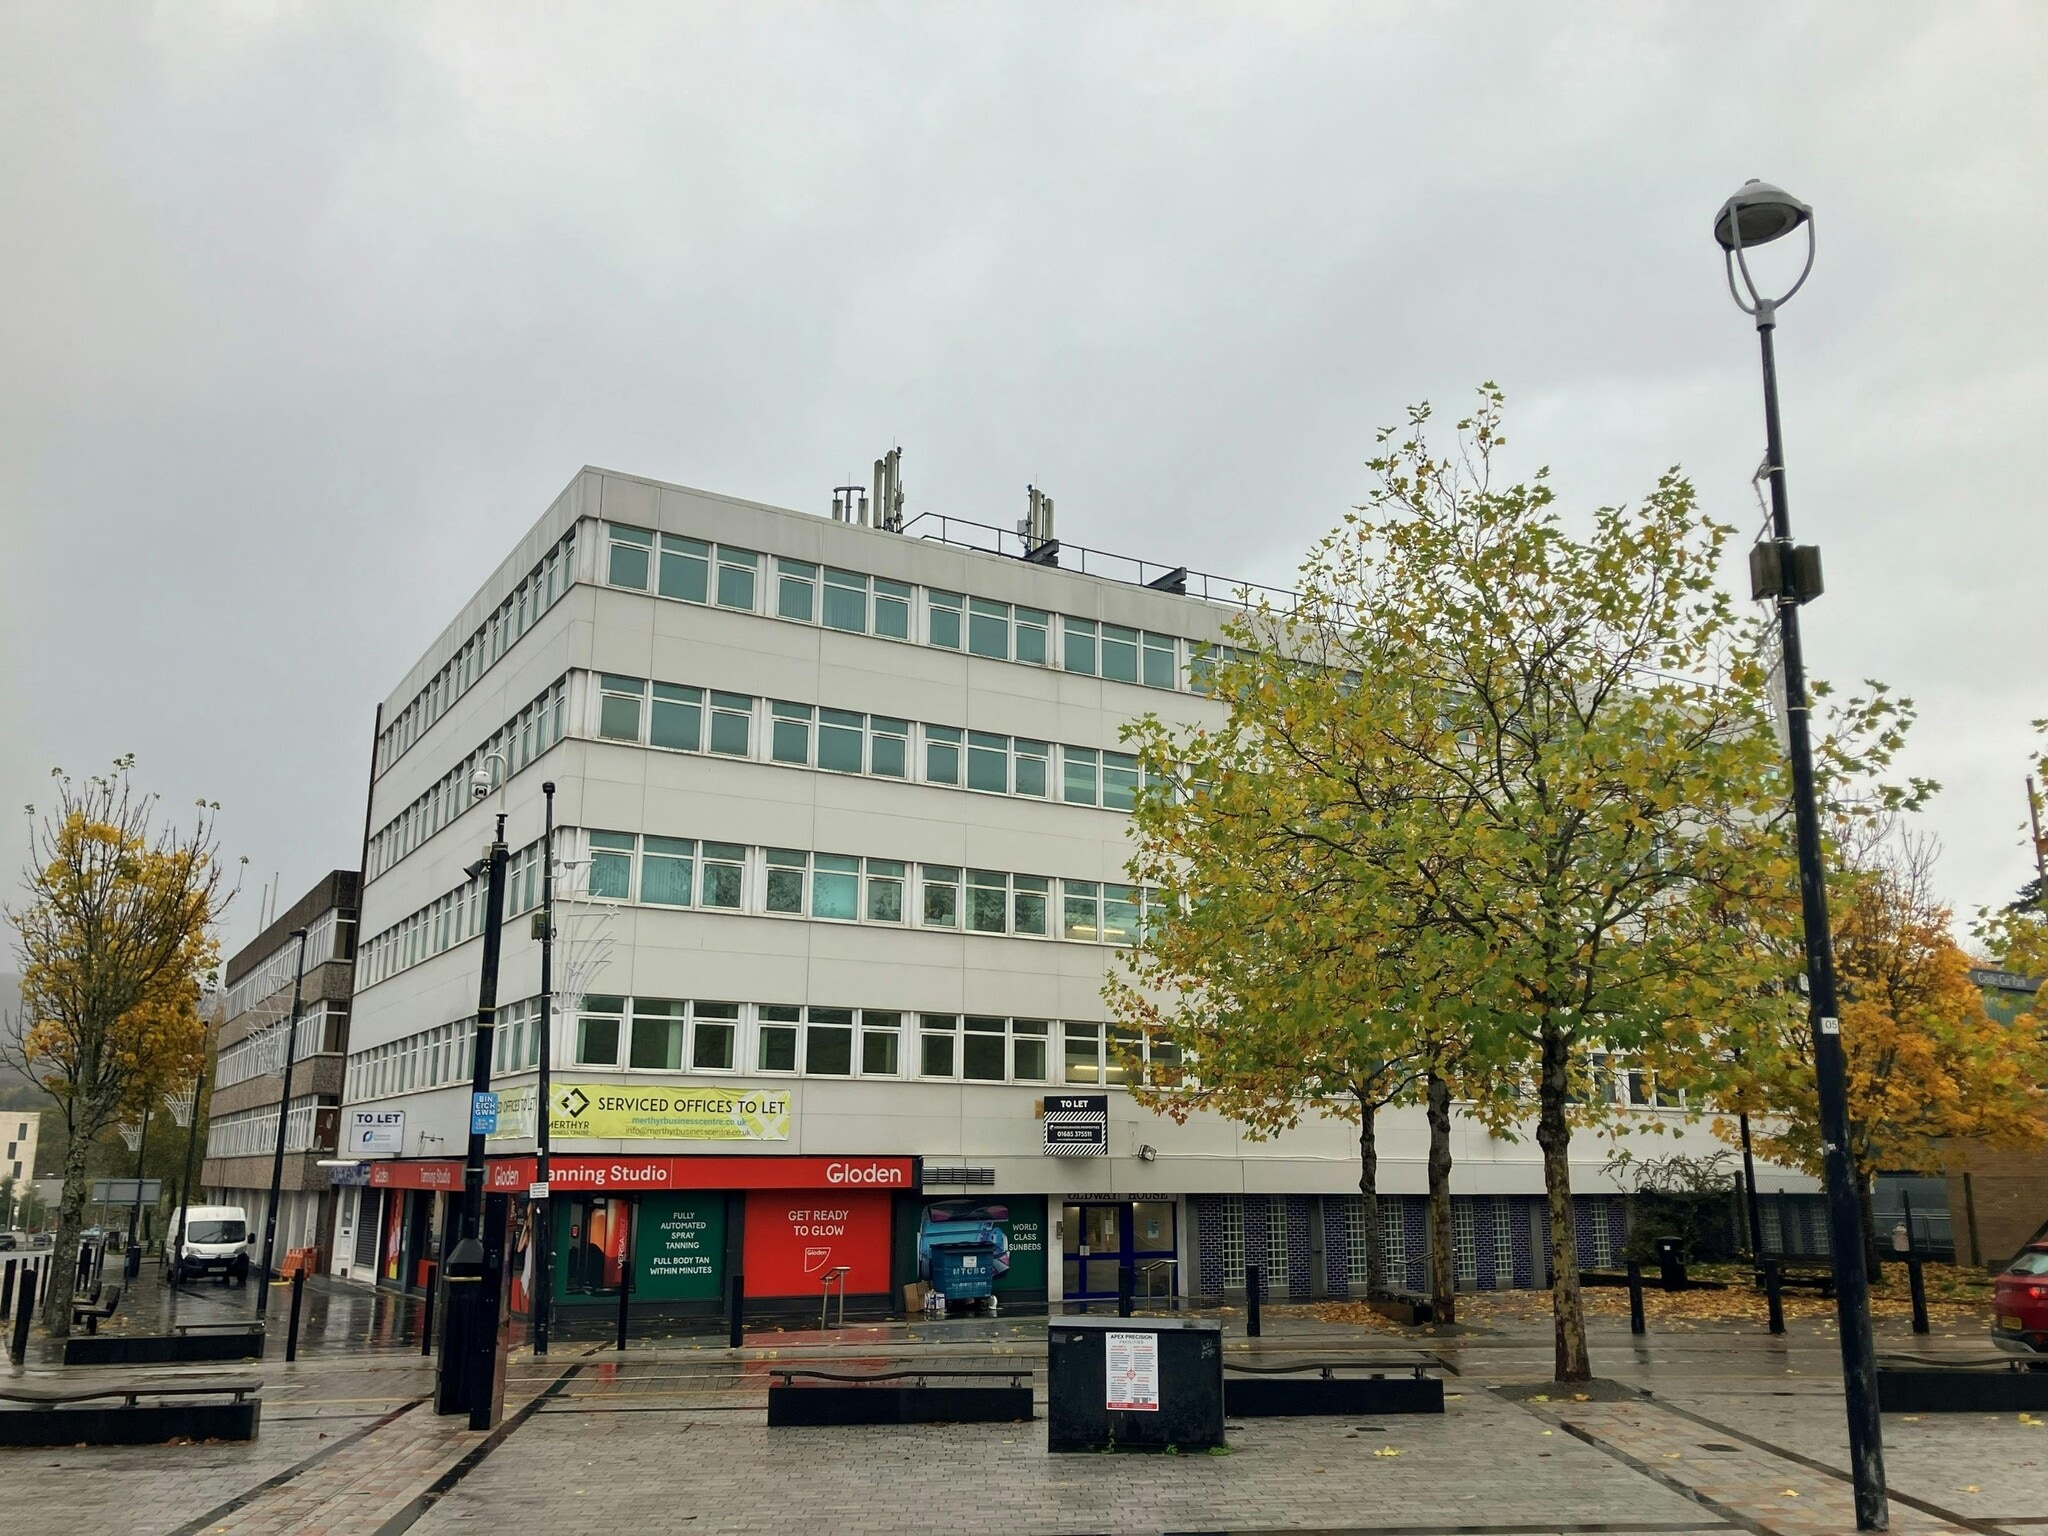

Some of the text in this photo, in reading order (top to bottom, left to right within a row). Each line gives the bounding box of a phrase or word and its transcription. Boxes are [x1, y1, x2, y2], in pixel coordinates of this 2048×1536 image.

[1825, 1019, 1838, 1030] 05
[479, 1095, 493, 1103] BIN
[475, 1102, 496, 1110] EICH
[598, 1097, 785, 1114] SERVICED OFFICES TO LET
[1060, 1100, 1089, 1108] TO LET
[357, 1114, 401, 1123] TO LET
[494, 1166, 519, 1187] Gloden
[549, 1164, 667, 1185] anning Studio
[826, 1163, 902, 1183] Gloden
[1127, 1192, 1169, 1200] HOUSE
[673, 1212, 696, 1220] FULLY
[788, 1210, 849, 1221] GET READY
[660, 1221, 707, 1230] AUTOMATED
[1012, 1223, 1038, 1231] WORLD
[793, 1225, 845, 1236] TO GLOW
[671, 1231, 696, 1240] SPRAY
[1013, 1233, 1037, 1241] CLASS
[665, 1241, 700, 1250] TANNING
[1008, 1243, 1042, 1251] SUNBEDS
[653, 1256, 711, 1265] FULL BODY TAN
[649, 1266, 713, 1275] WITHIN MINUTES
